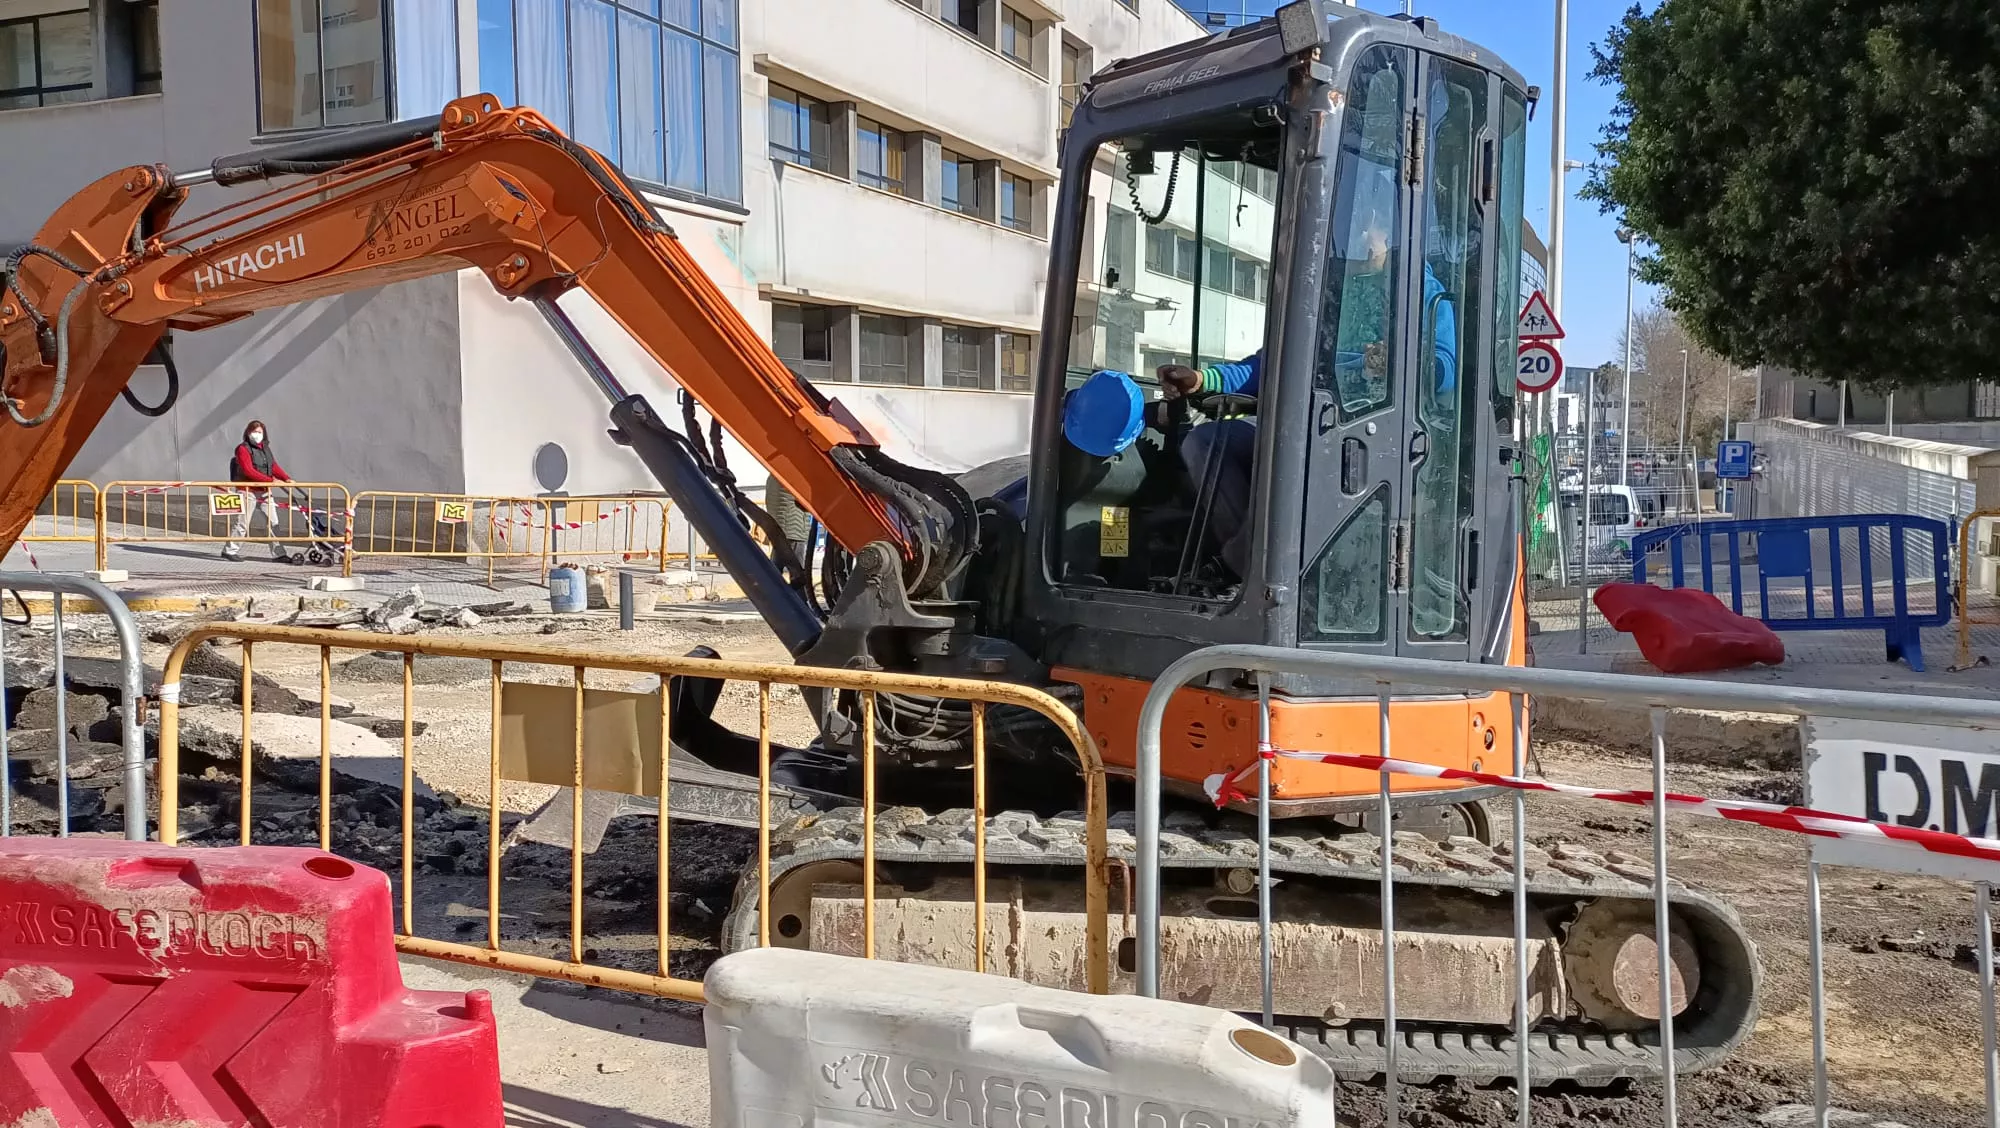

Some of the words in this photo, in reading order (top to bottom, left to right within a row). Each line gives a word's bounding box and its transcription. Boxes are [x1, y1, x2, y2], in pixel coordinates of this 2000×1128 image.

[1143, 74, 1185, 94] FIRMA
[1186, 65, 1220, 83] BEEL
[366, 243, 397, 261] 692
[403, 234, 432, 250] 201
[440, 223, 472, 239] 022
[194, 233, 306, 294] HITACHI
[1519, 356, 1550, 374] 20
[1725, 445, 1744, 463] P
[50, 903, 317, 962] SAFEBLOCK
